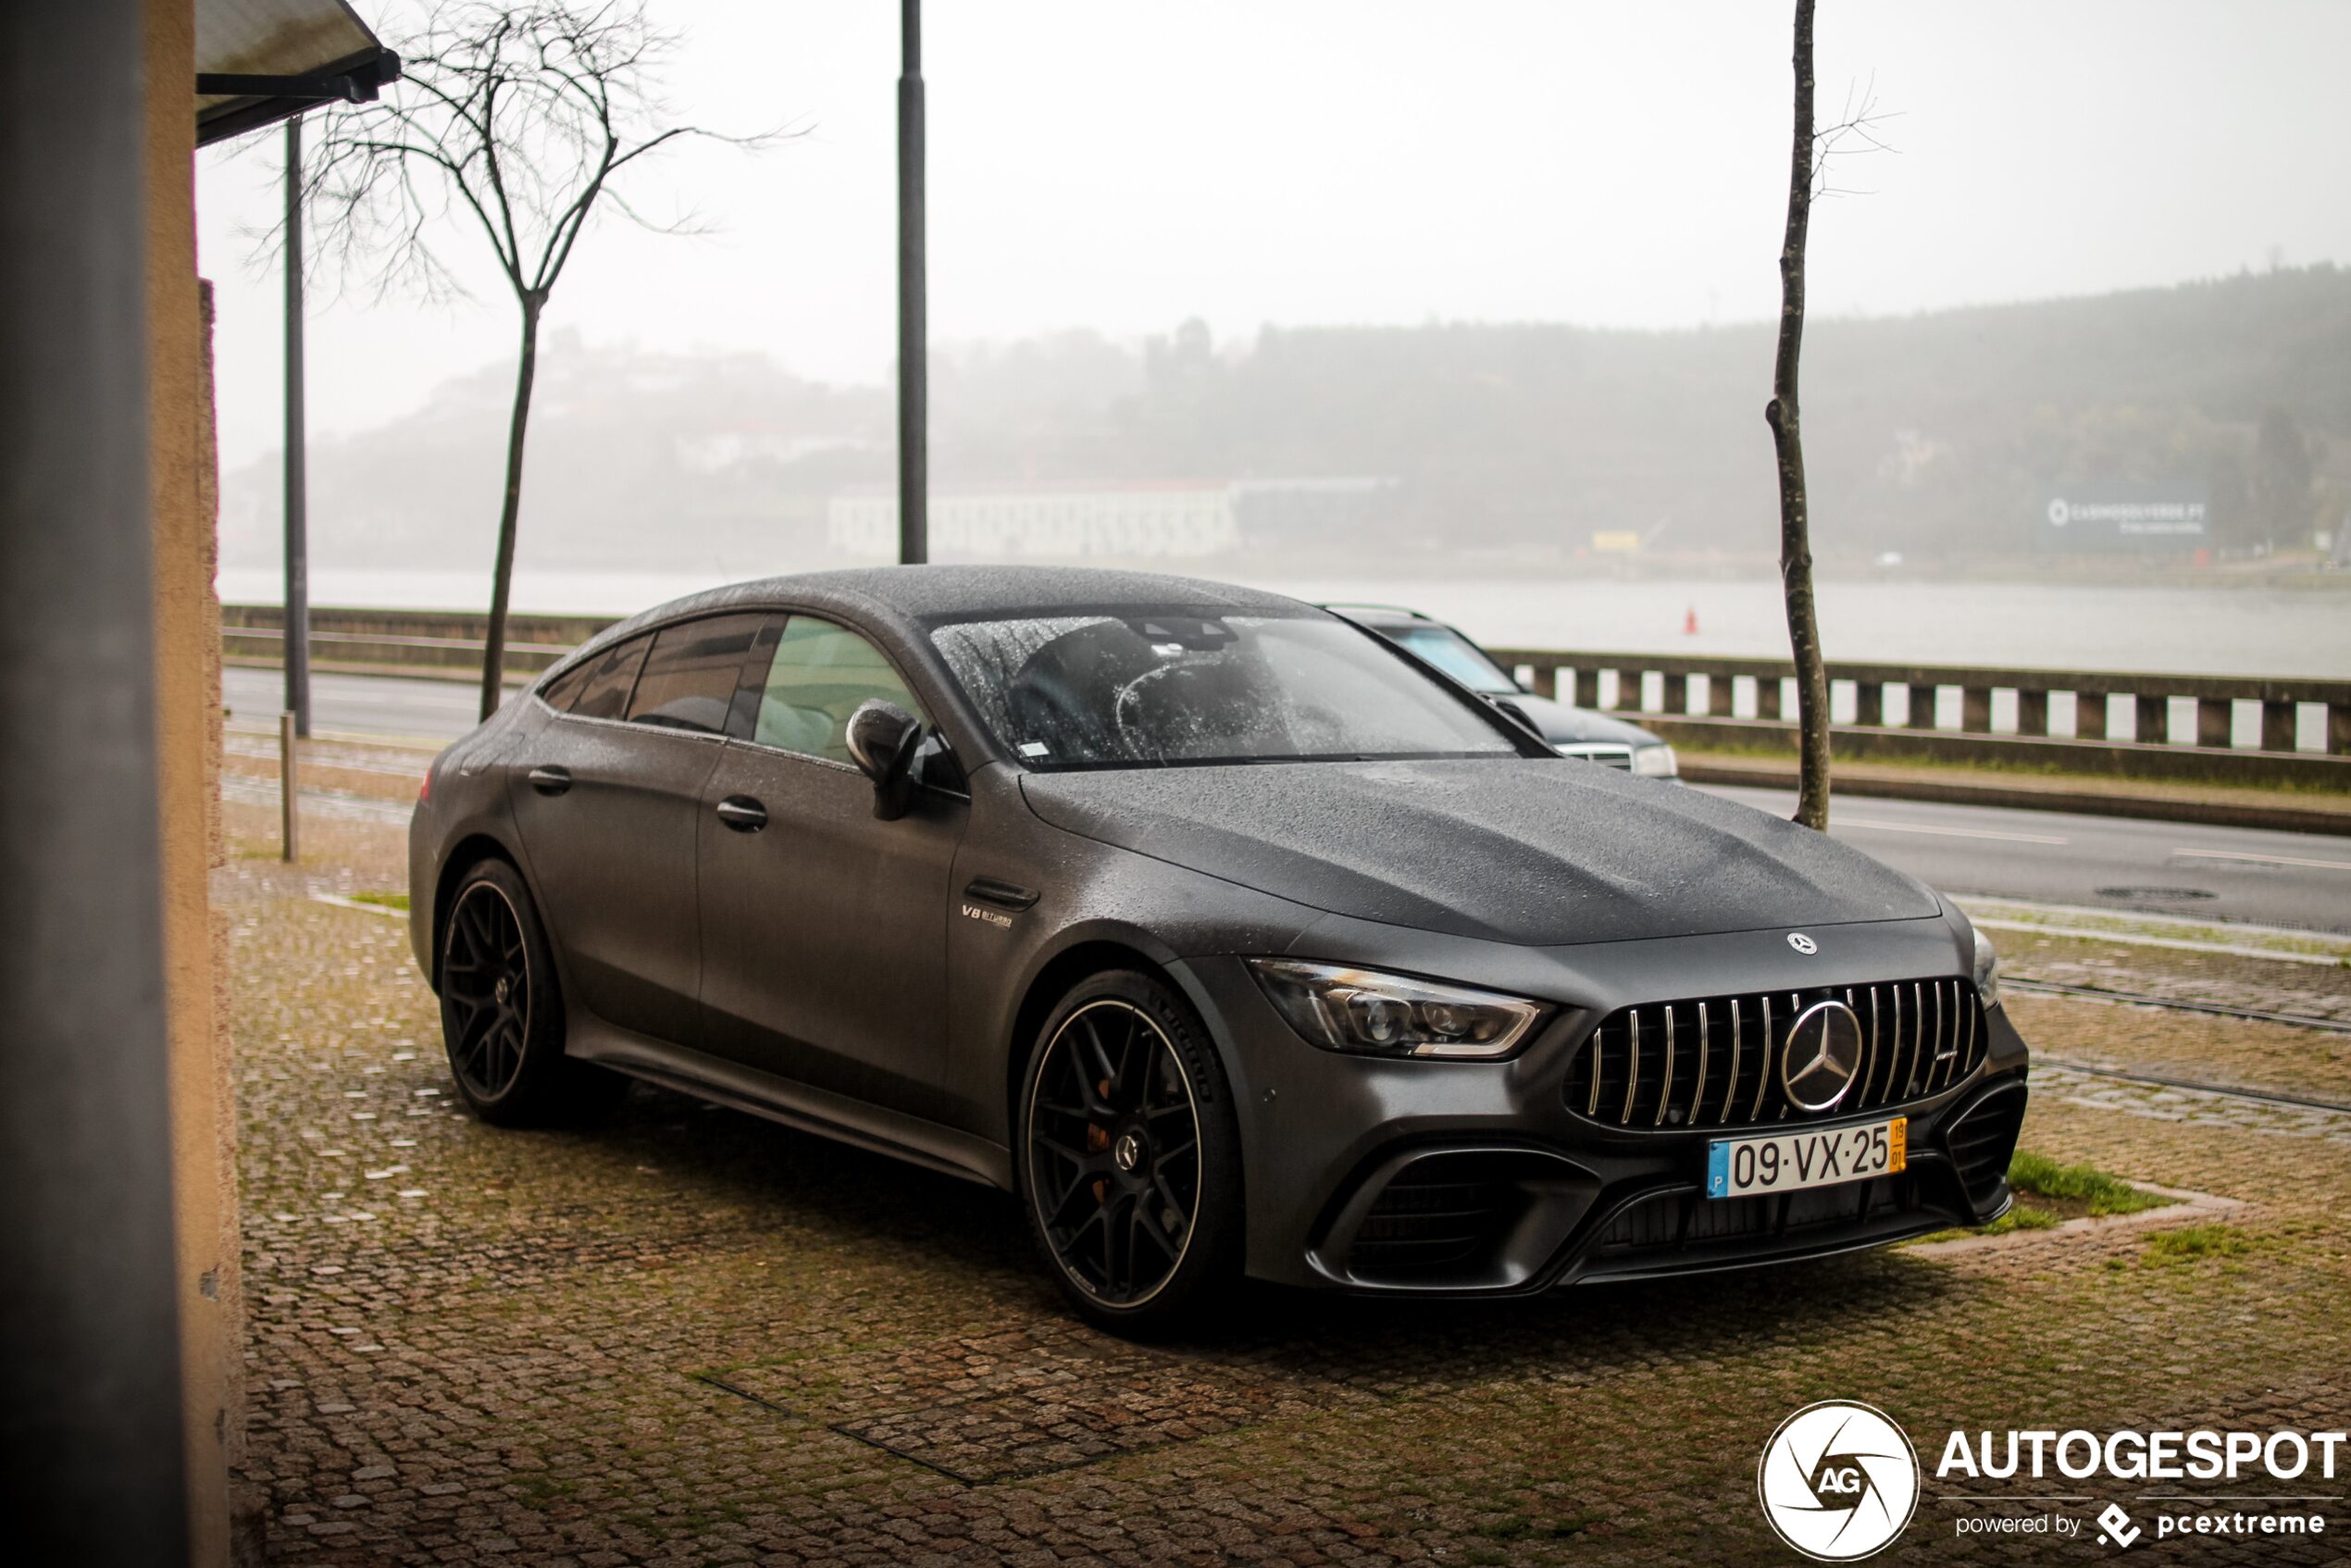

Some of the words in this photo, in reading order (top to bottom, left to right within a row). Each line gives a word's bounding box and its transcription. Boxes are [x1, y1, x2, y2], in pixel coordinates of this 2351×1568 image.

[962, 904, 981, 919] V8
[1162, 1006, 1211, 1099] MICHELIN
[1895, 1124, 1904, 1139] 19
[1892, 1151, 1901, 1166] 01
[1714, 1176, 1723, 1188] P
